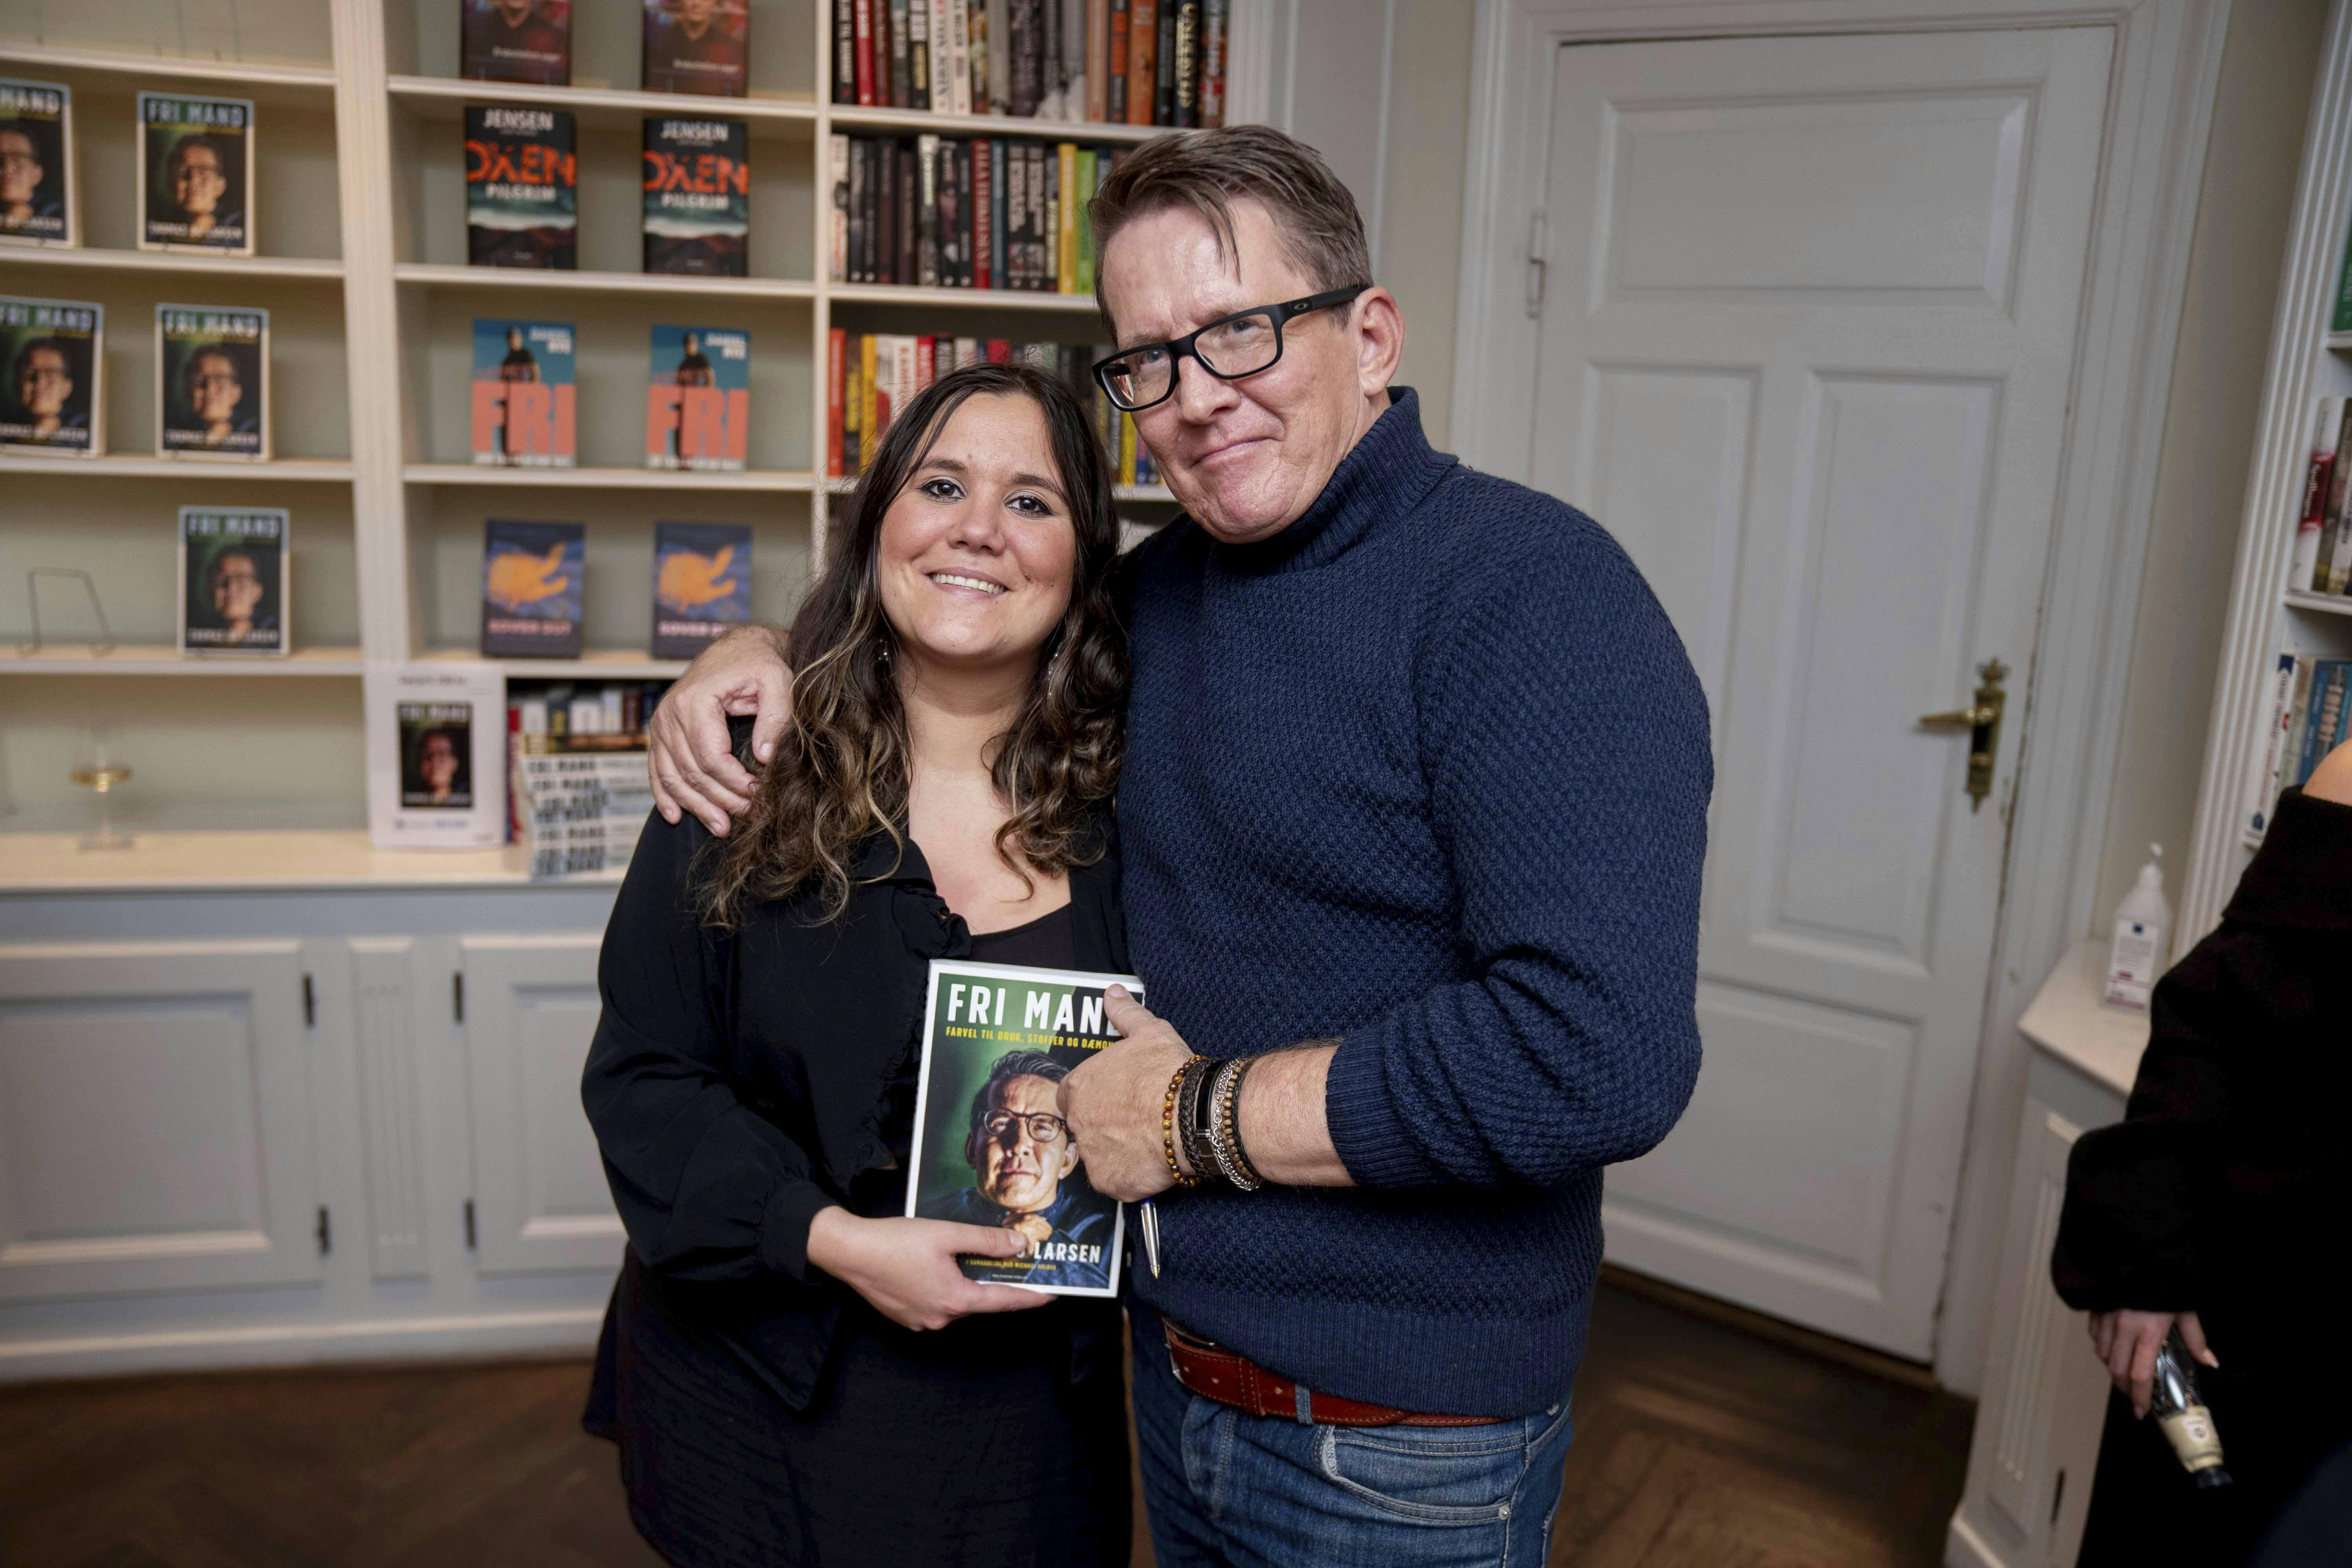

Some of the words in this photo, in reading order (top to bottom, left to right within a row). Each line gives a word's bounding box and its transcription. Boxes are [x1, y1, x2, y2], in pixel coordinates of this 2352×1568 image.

[148, 100, 179, 122] FRI
[187, 104, 243, 127] MAND
[483, 109, 554, 131] JENSEN
[661, 120, 729, 141] JENSEN
[486, 183, 556, 201] PILGRIM
[661, 192, 729, 210] PILGRIM
[474, 380, 576, 456] FRI
[646, 383, 750, 459] FRI
[947, 983, 1006, 1026] FRI
[946, 1026, 977, 1039] FARVEL
[981, 1029, 994, 1040] TIL
[997, 1031, 1024, 1043] DRUK,
[1027, 1034, 1063, 1045] STOFFER
[1067, 1037, 1078, 1047] OG
[1033, 1241, 1101, 1263] LARSEN
